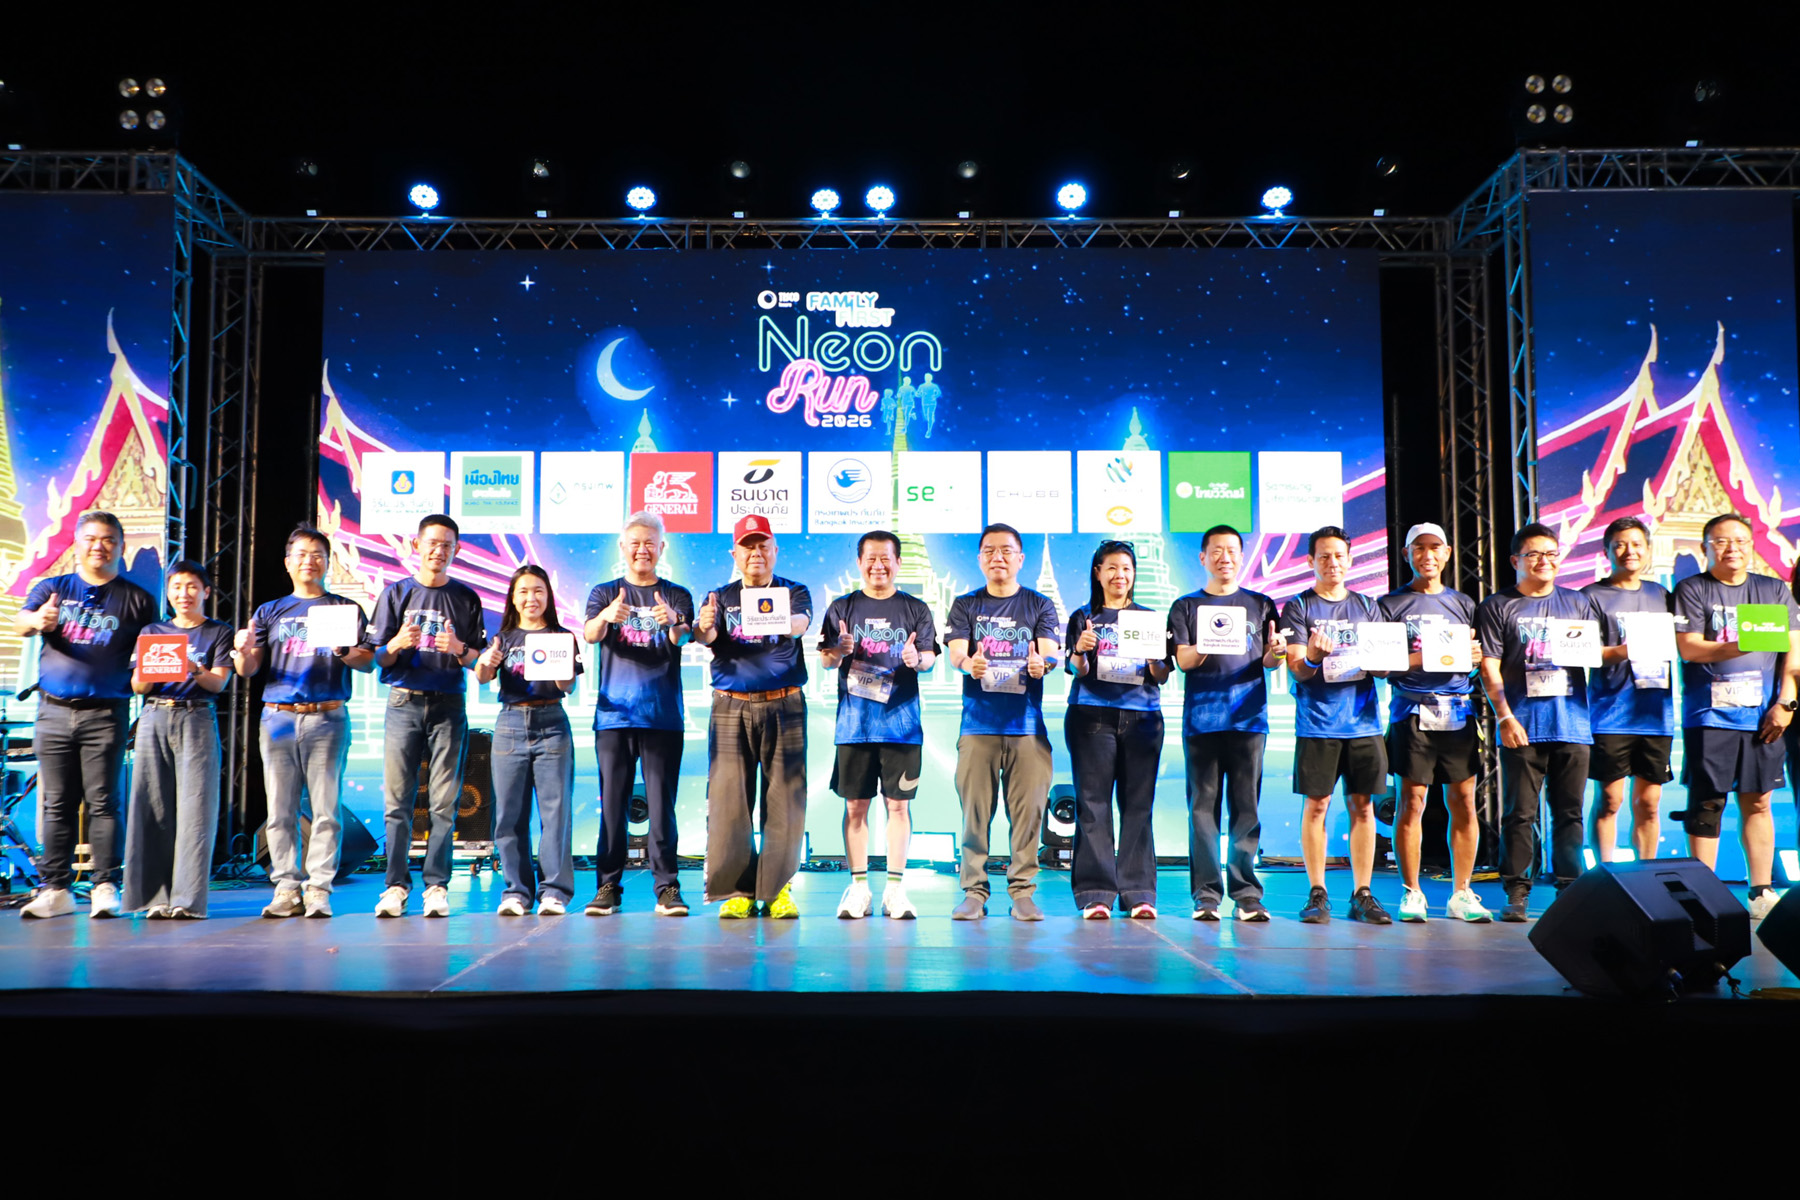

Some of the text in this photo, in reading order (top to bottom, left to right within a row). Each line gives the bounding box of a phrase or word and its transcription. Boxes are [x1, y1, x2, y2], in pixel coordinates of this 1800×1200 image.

[836, 308, 896, 327] FIRST
[758, 315, 942, 373] Neon
[766, 358, 879, 427] Run
[821, 414, 873, 428] 2026
[464, 469, 520, 486] เมืองไทย
[731, 488, 789, 502] ธนชาต
[996, 490, 1060, 498] CHUBB
[644, 503, 698, 515] GENERALI
[731, 502, 789, 515] ประกันภัย
[854, 623, 908, 643] Neon
[974, 622, 1033, 642] Neon
[861, 637, 889, 657] Run
[981, 636, 1014, 657] Run
[549, 650, 568, 659] TISCO
[142, 665, 182, 674] GENERALI
[1110, 661, 1128, 671] VIP
[857, 675, 873, 686] VIP
[992, 671, 1011, 681] VIP
